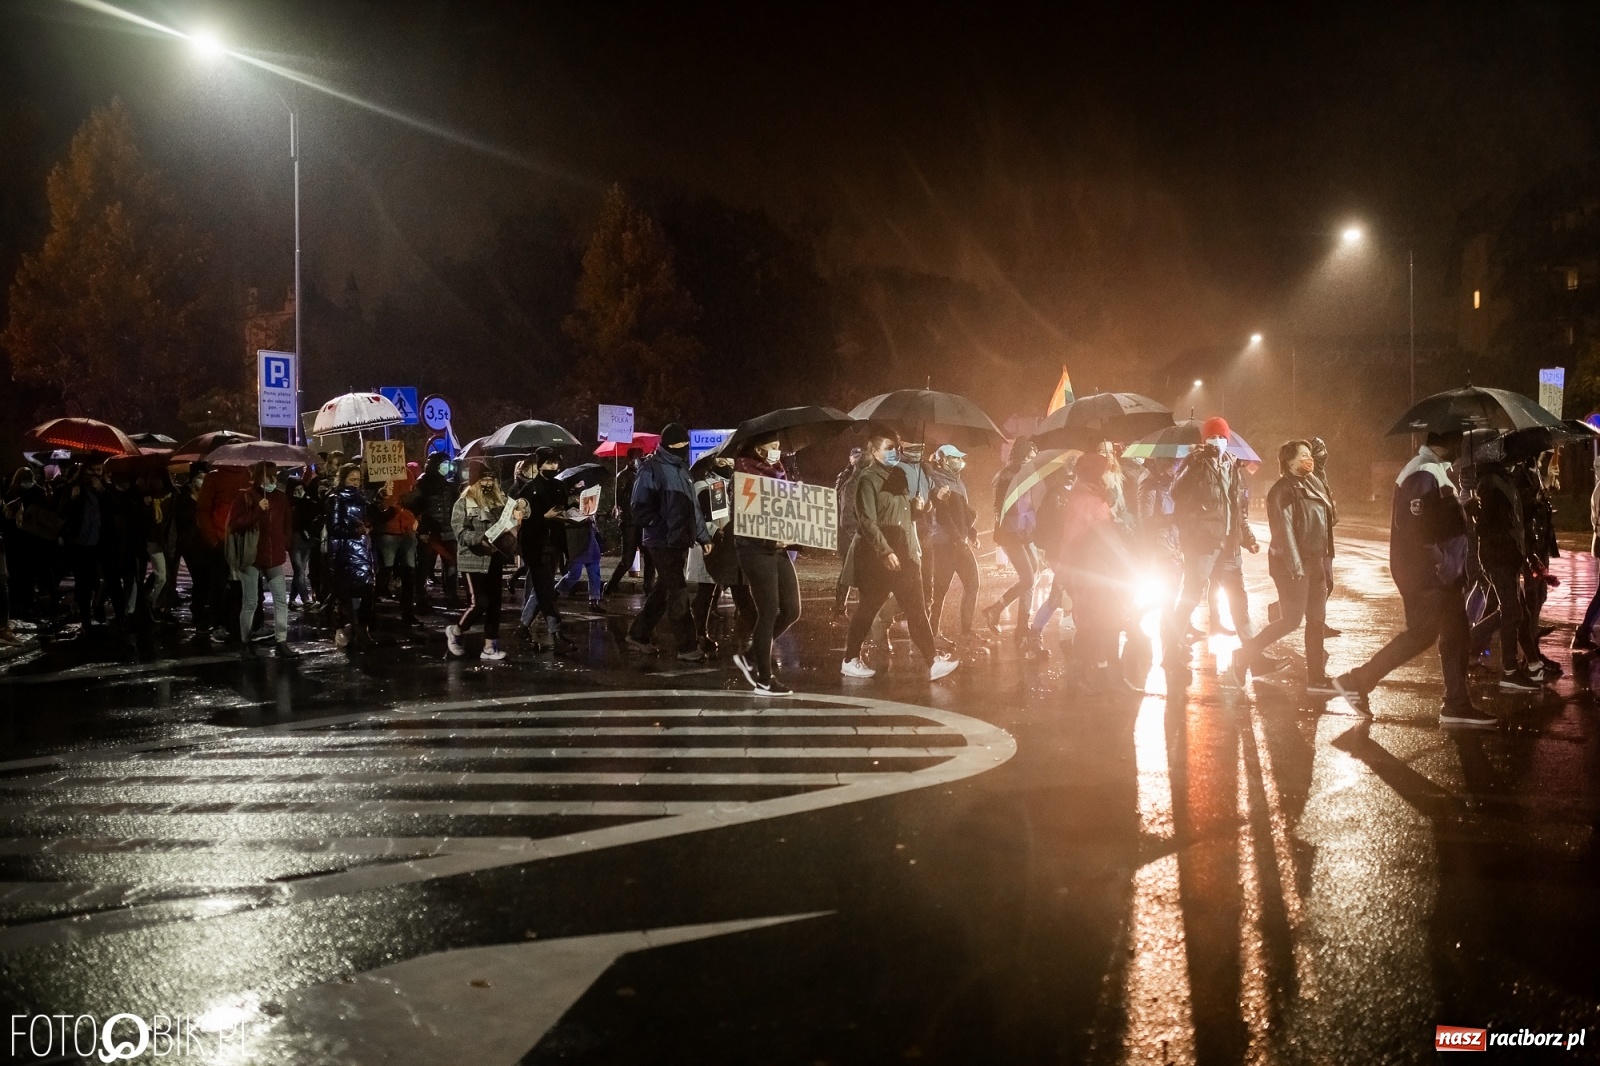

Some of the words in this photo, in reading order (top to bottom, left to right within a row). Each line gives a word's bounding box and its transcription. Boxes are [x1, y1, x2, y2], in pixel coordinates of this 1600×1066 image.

[270, 360, 285, 385] P
[426, 405, 449, 421] 3,5t
[611, 415, 629, 423] POLKA
[371, 453, 404, 464] DOBREM
